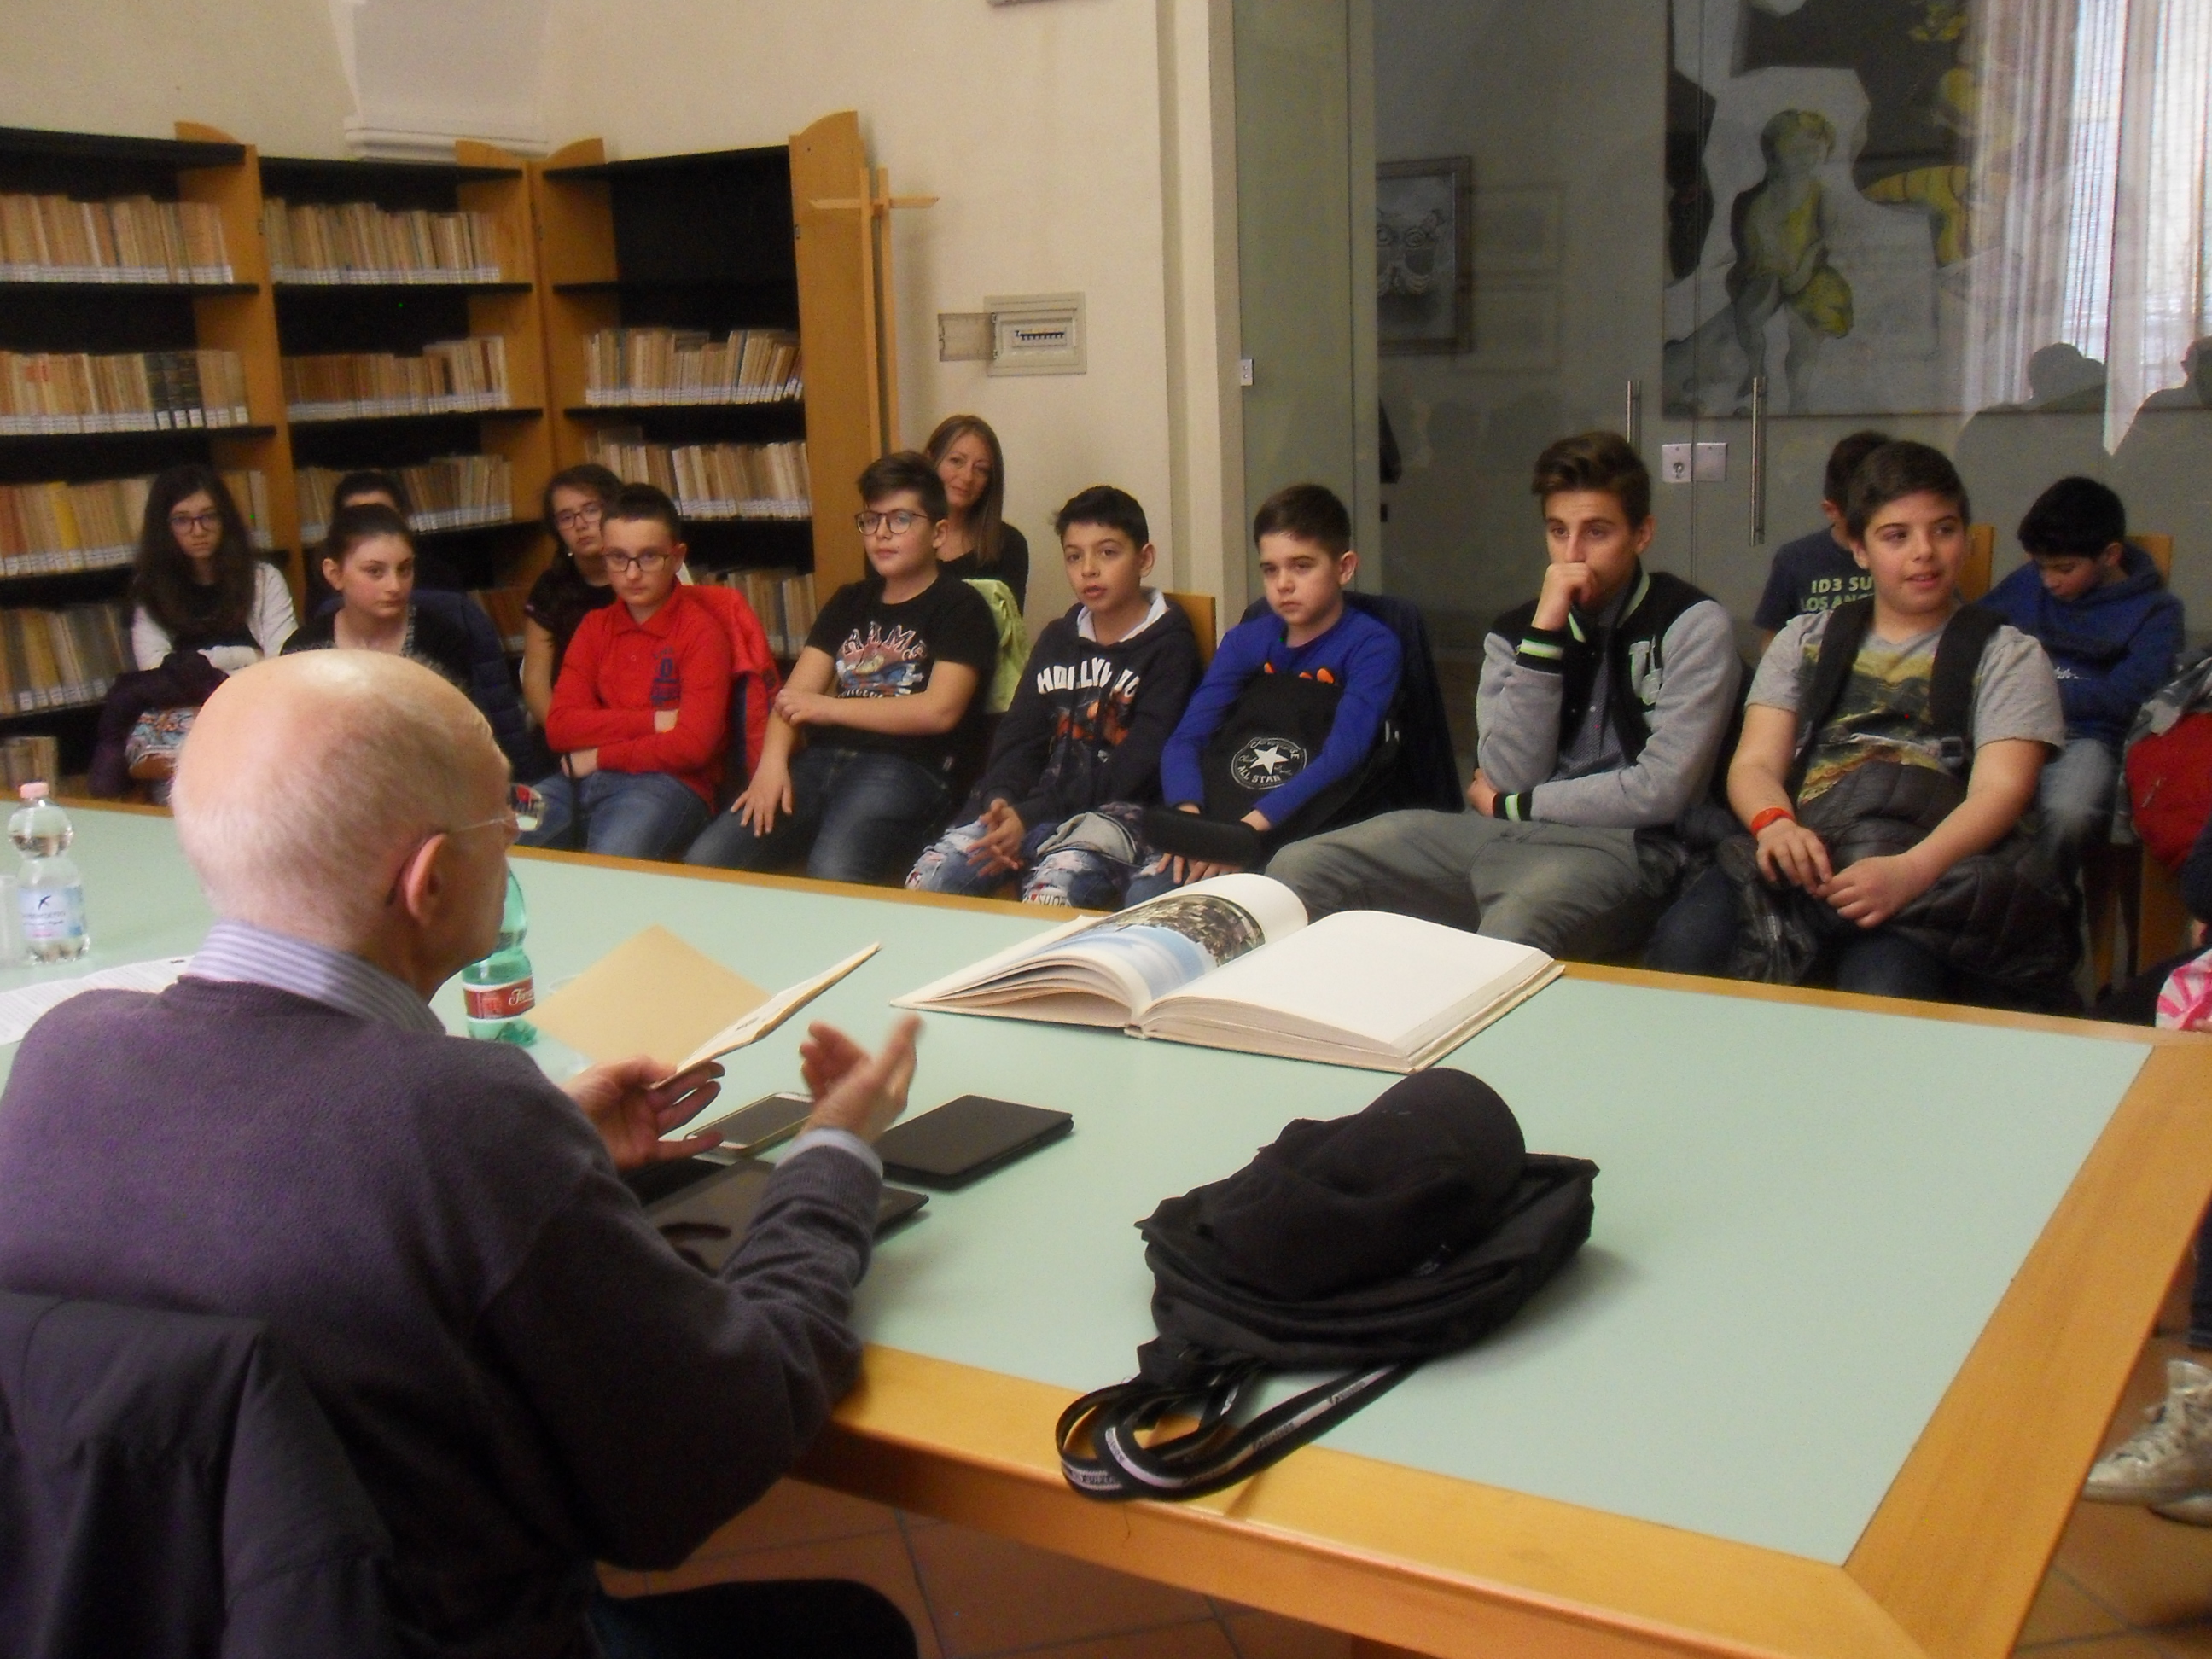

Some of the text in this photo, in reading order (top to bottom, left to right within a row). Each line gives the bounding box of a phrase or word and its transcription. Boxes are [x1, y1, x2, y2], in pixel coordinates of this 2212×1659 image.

[1812, 576, 1873, 594] ID3 SU
[1801, 597, 1828, 612] LOS
[1237, 765, 1281, 783] ALL STAR
